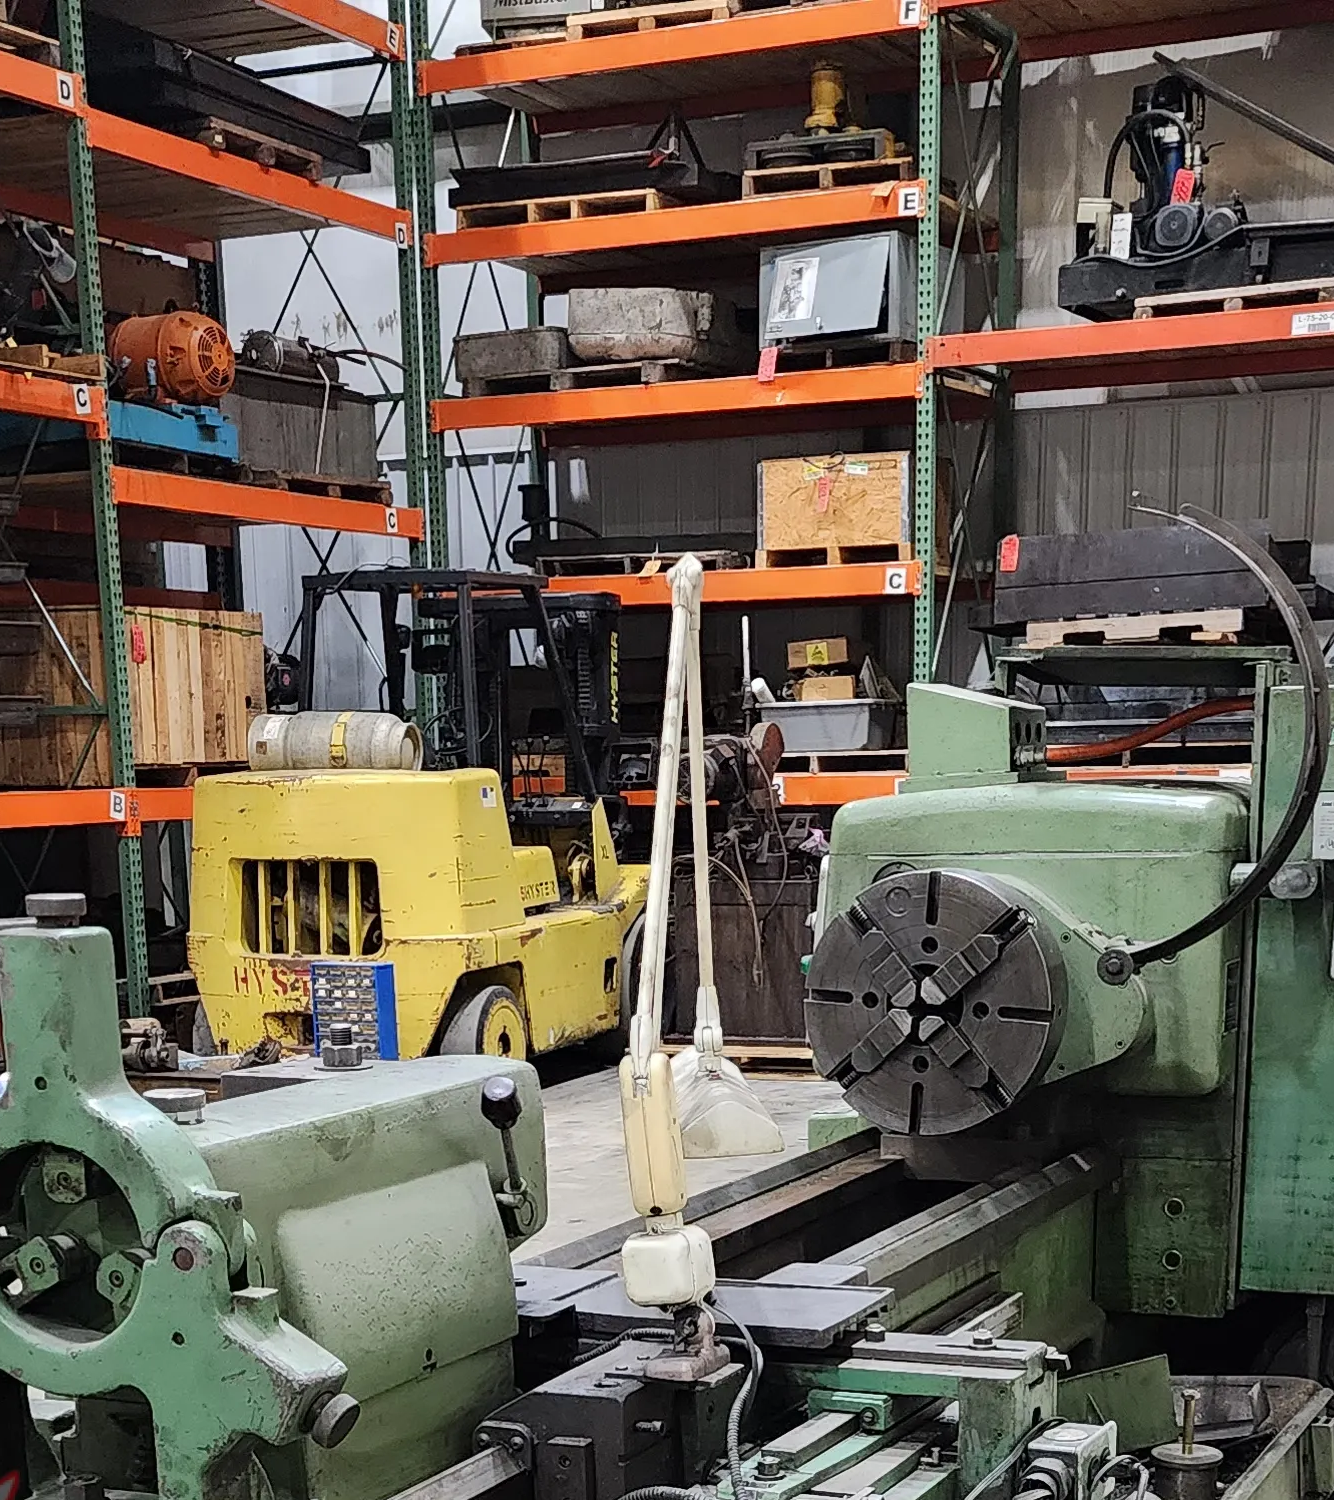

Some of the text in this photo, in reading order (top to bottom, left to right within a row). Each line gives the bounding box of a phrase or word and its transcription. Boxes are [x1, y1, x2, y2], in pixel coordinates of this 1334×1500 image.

[904, 1, 917, 20] F
[389, 27, 397, 48] E
[59, 79, 70, 100] D
[903, 192, 916, 211] E
[398, 227, 405, 245] D
[76, 387, 87, 407] C
[388, 512, 396, 529] C
[889, 573, 902, 589] C
[610, 631, 618, 724] HYSTER
[113, 794, 123, 814] B
